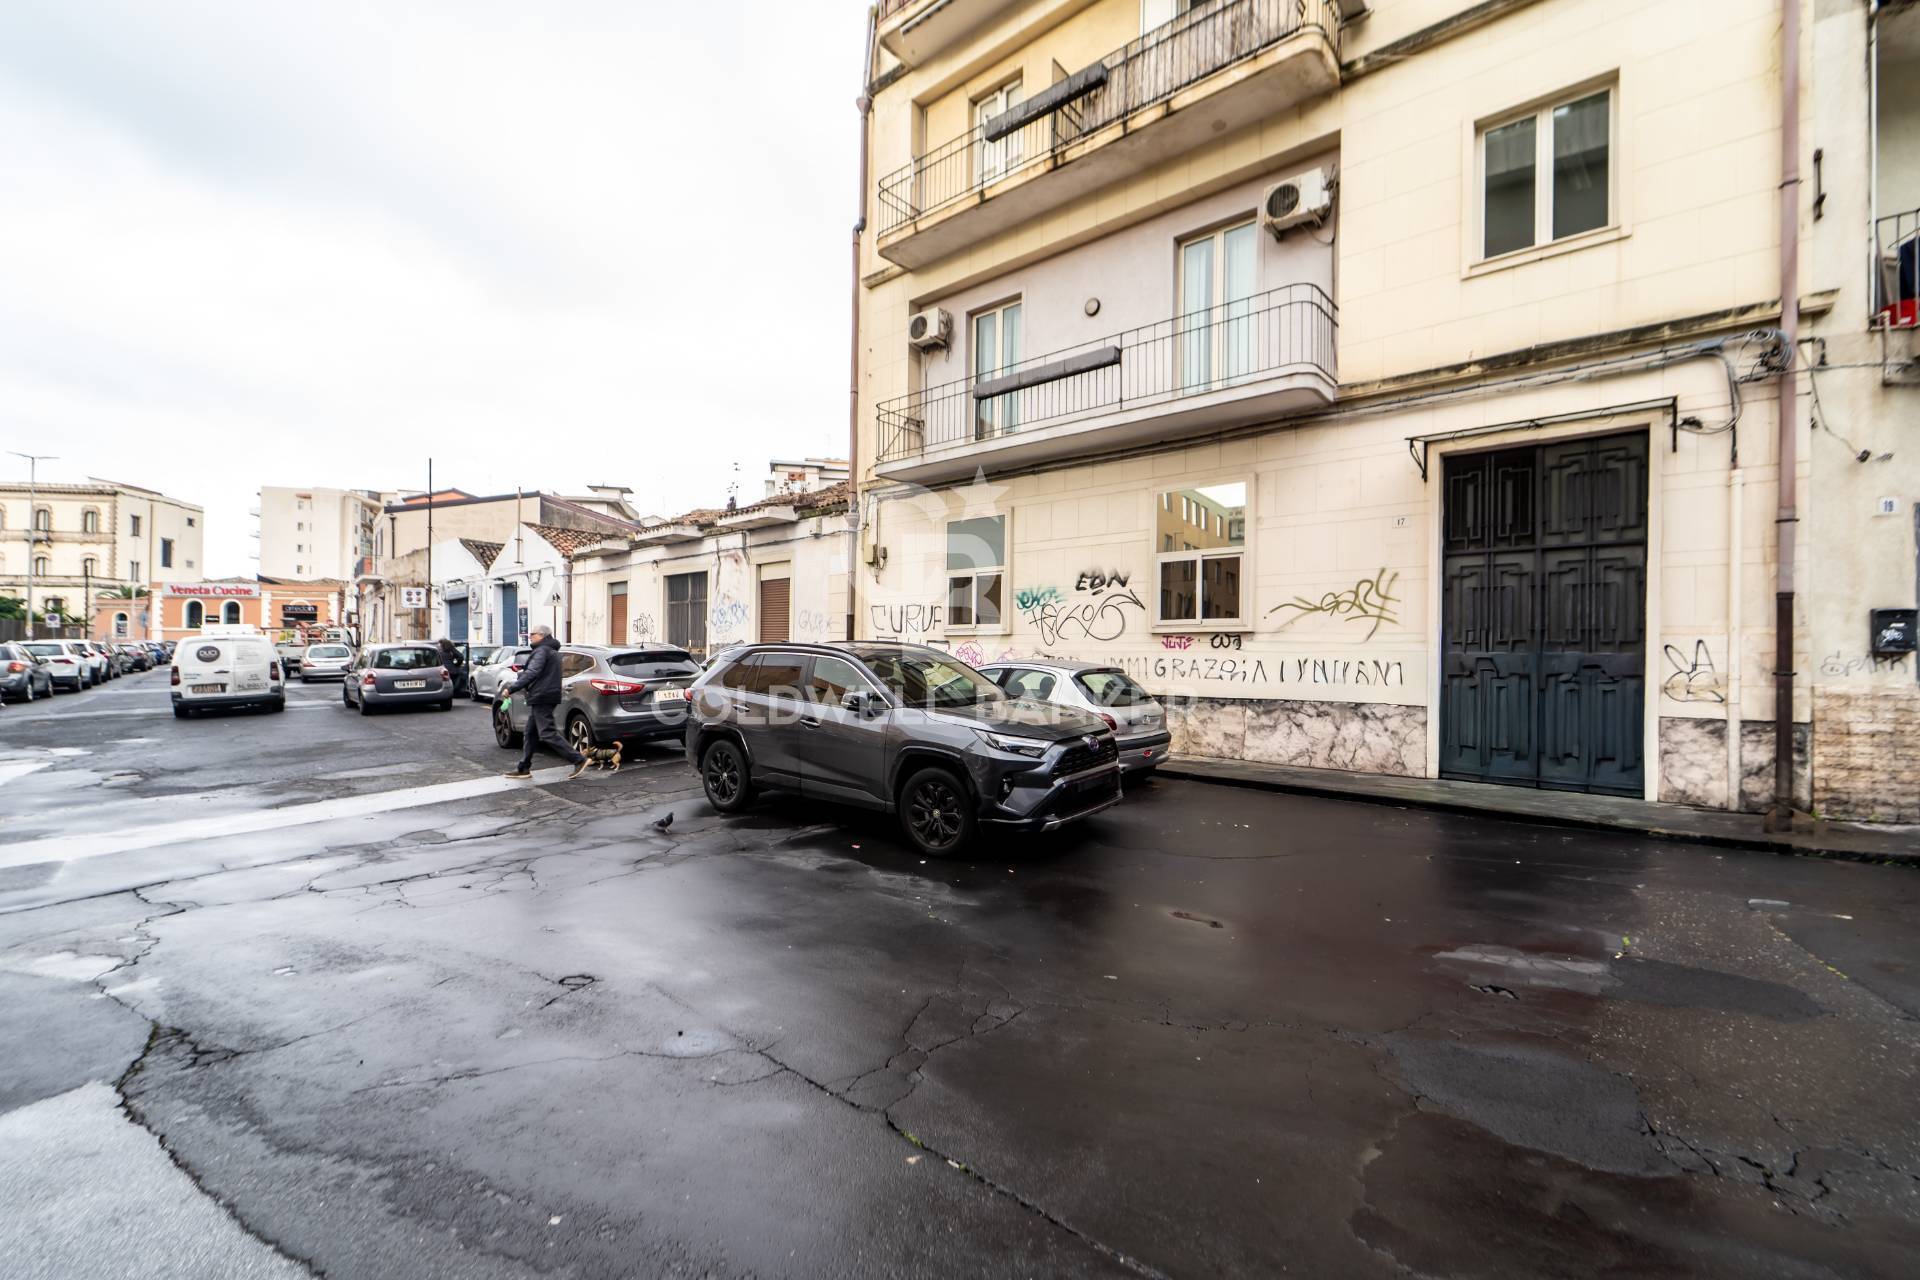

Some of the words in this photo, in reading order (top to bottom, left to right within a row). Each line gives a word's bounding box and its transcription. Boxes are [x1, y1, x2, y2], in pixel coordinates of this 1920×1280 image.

[1397, 517, 1406, 526] 17
[170, 585, 210, 595] Veneta
[212, 585, 254, 595] Cucine
